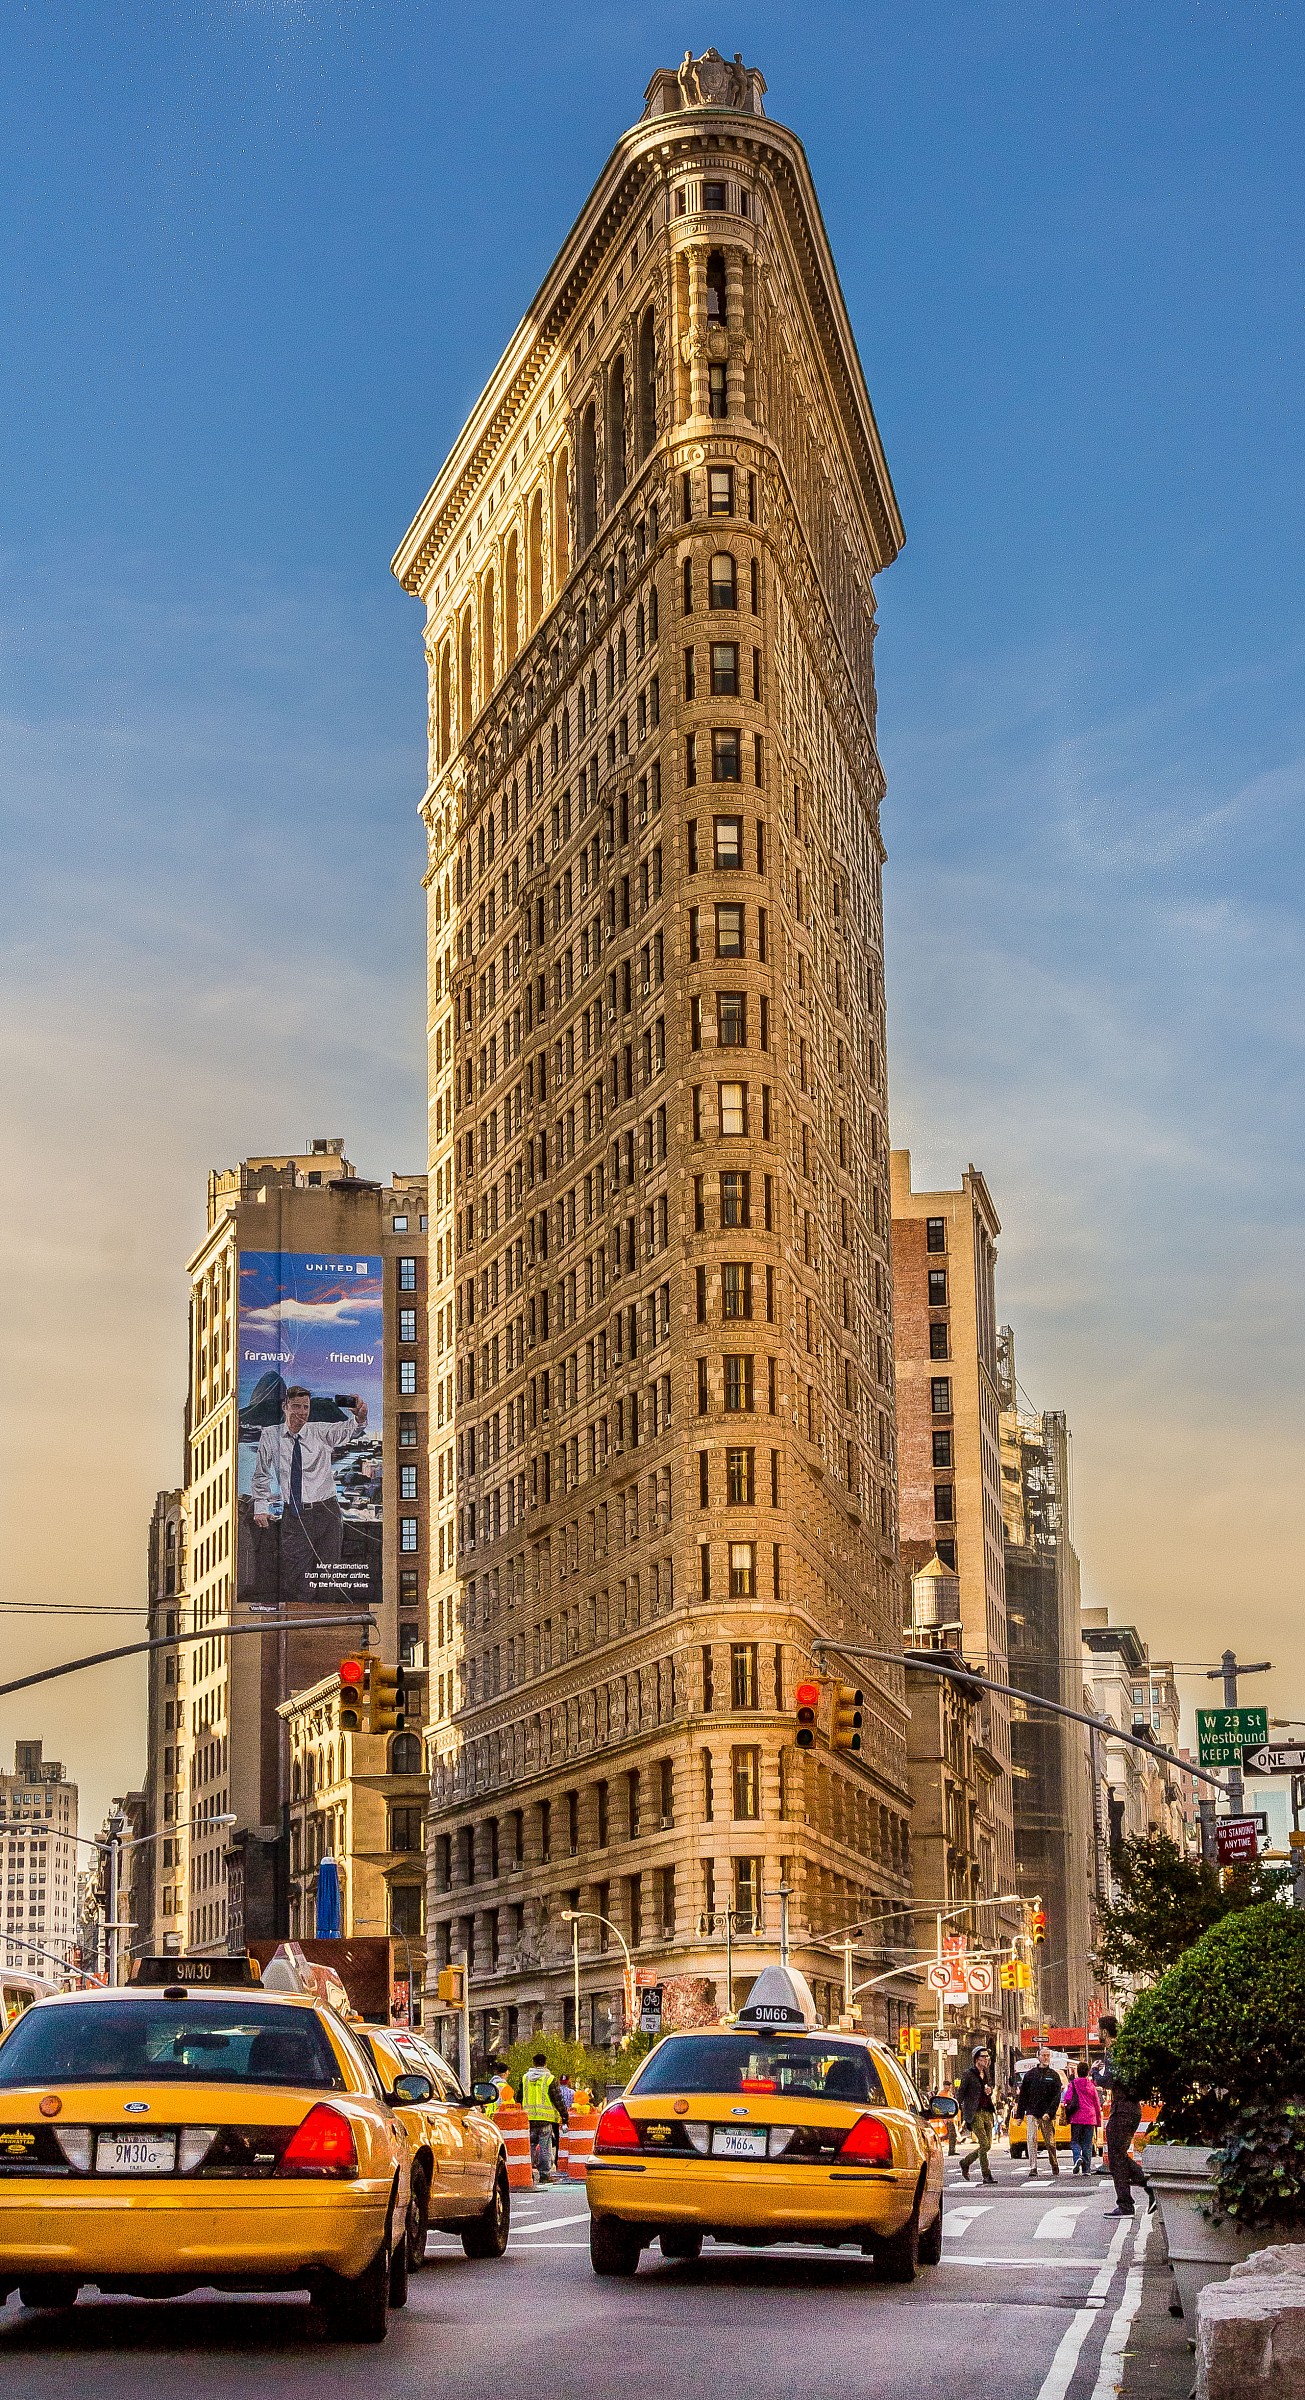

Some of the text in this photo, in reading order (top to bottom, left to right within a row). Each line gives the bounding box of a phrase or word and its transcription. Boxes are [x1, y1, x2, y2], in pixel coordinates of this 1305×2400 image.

[306, 1264, 353, 1272] UNITED
[244, 1351, 374, 1365] faraway friendly
[1204, 1714, 1261, 1728] W 23 St
[1201, 1730, 1266, 1745] Westbound
[1202, 1748, 1230, 1761] KEEP
[1257, 1753, 1286, 1766] ONE
[1218, 1825, 1254, 1839] NO STANDING
[1224, 1837, 1252, 1850] ANYTIME
[176, 1963, 211, 1980] 9M30
[756, 2007, 788, 2021] 9M66
